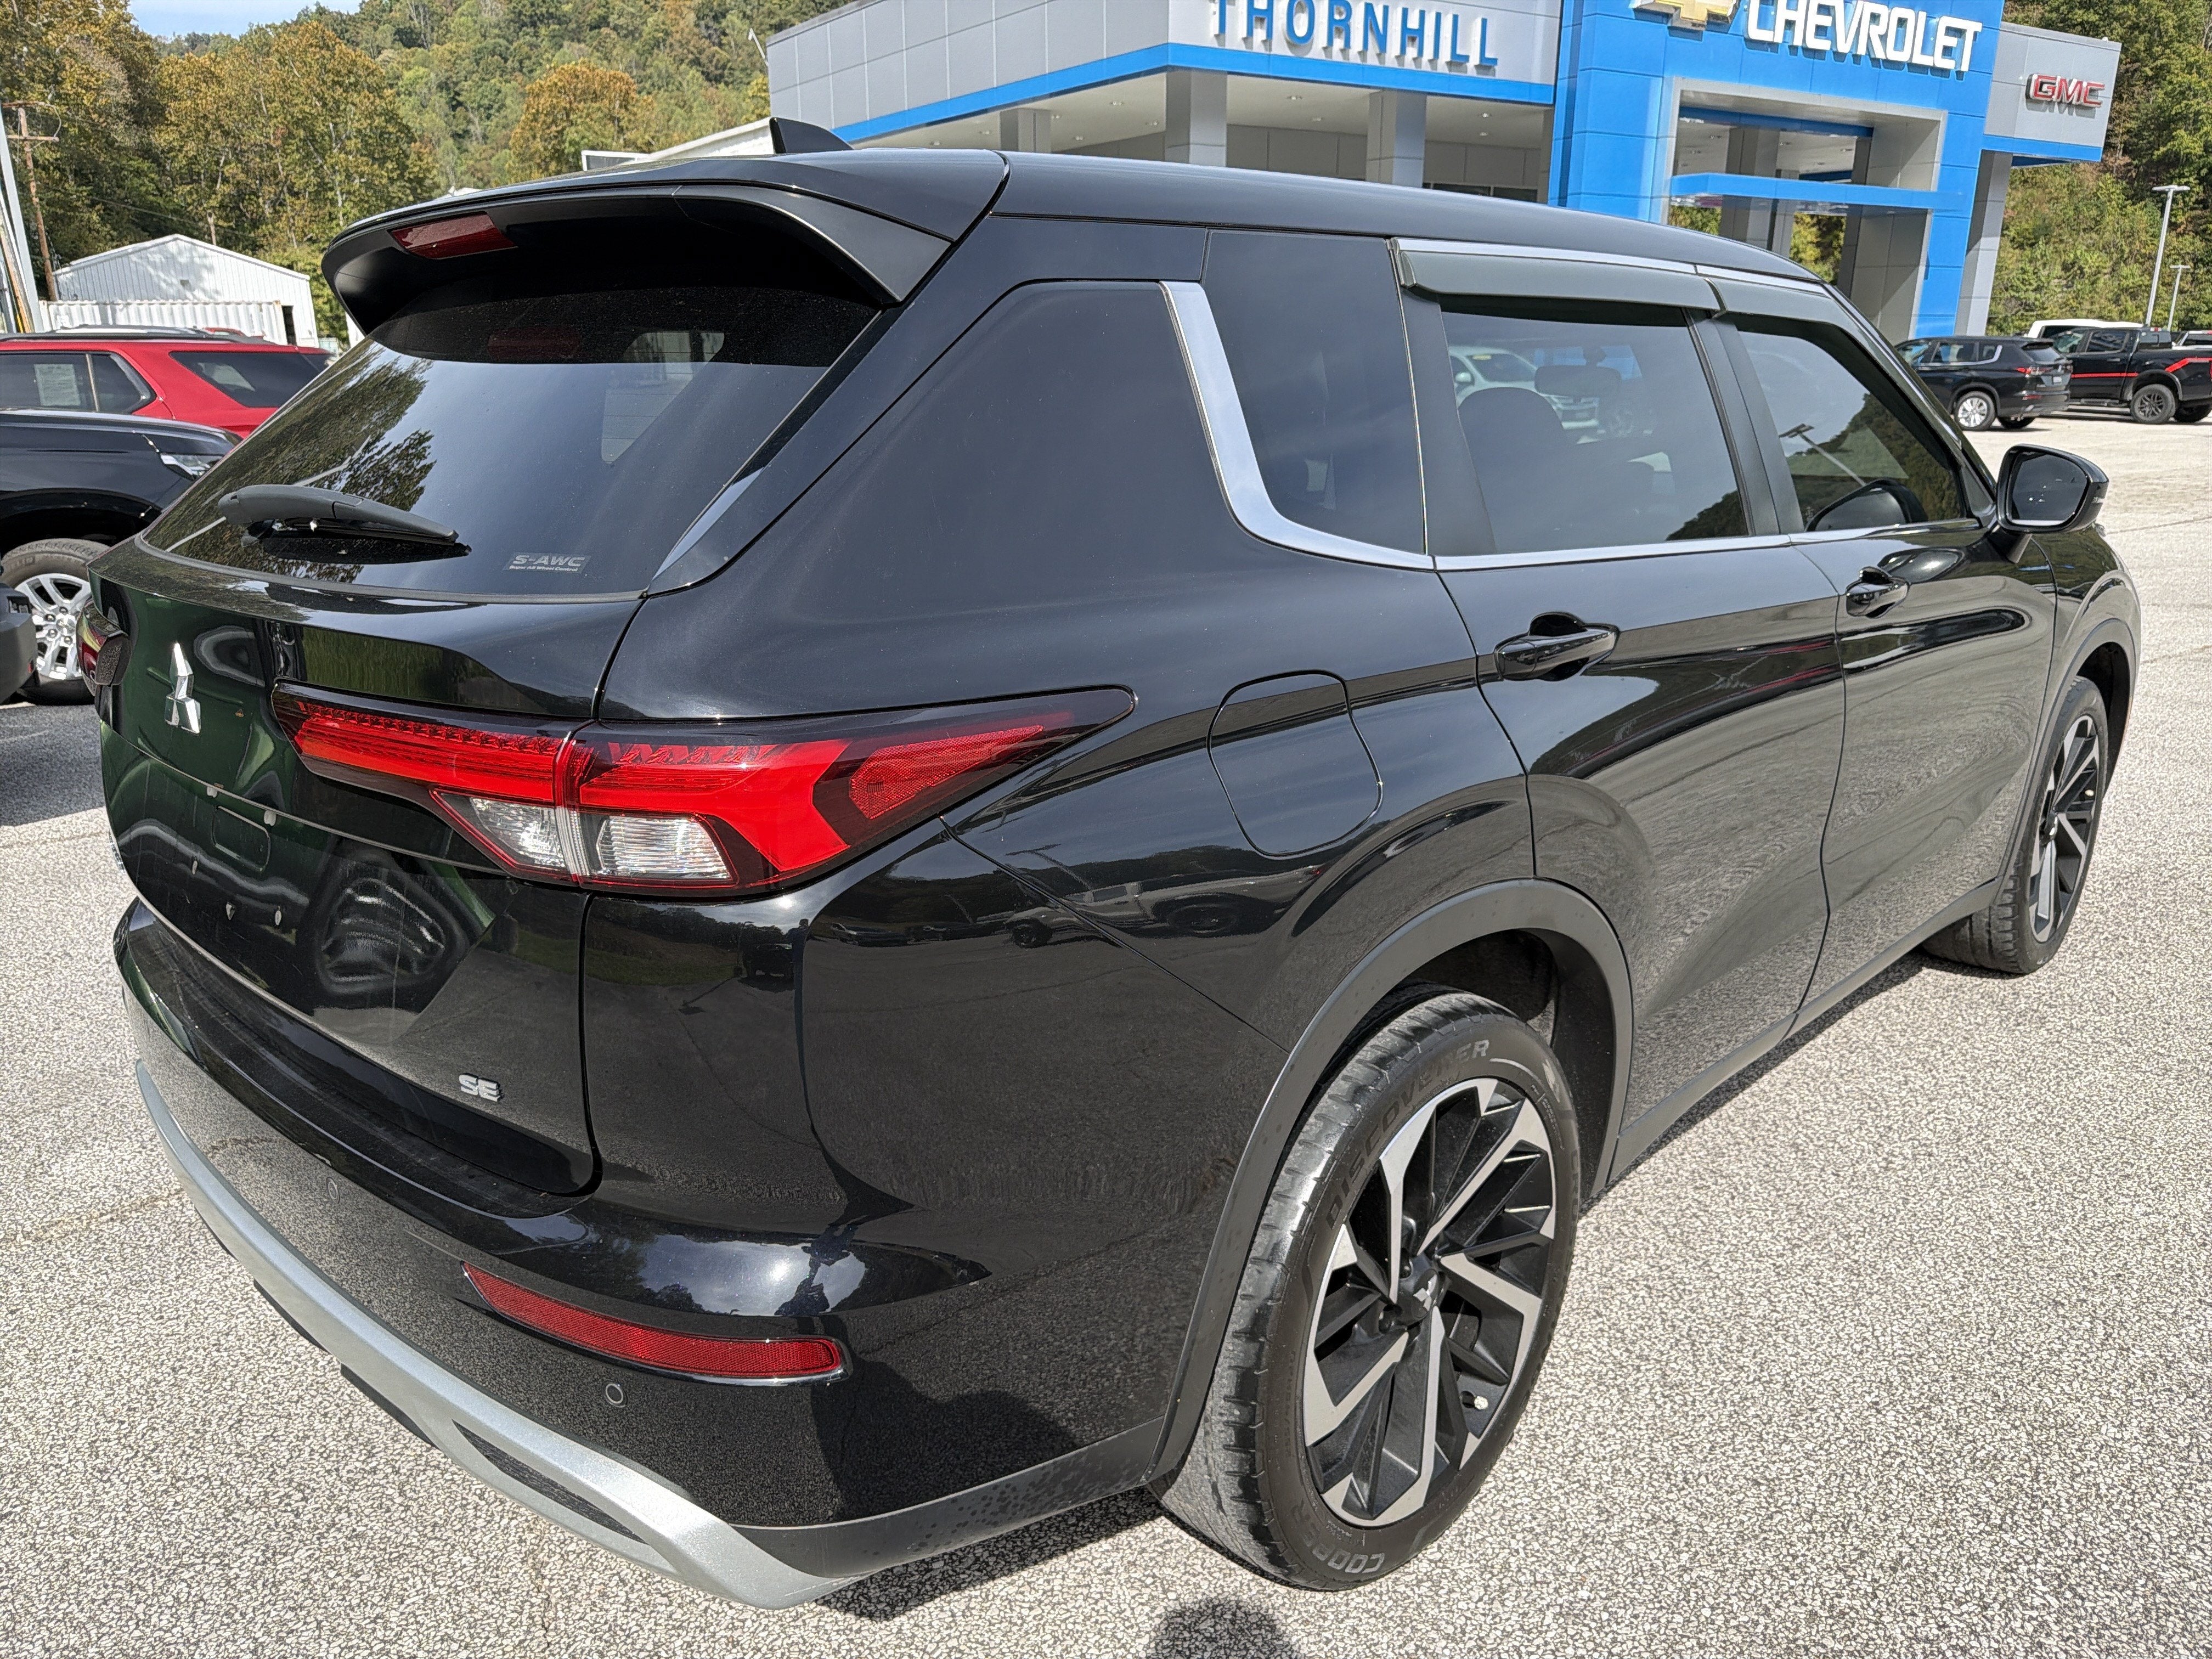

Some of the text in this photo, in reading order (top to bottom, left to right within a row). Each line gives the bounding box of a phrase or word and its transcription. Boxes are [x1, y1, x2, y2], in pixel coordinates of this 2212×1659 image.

[1211, 0, 1498, 66] THORNHILL
[1746, 0, 1982, 72] CHEVROLET
[2029, 74, 2106, 108] GMC
[512, 554, 585, 567] S-AWC
[459, 1074, 501, 1102] SE
